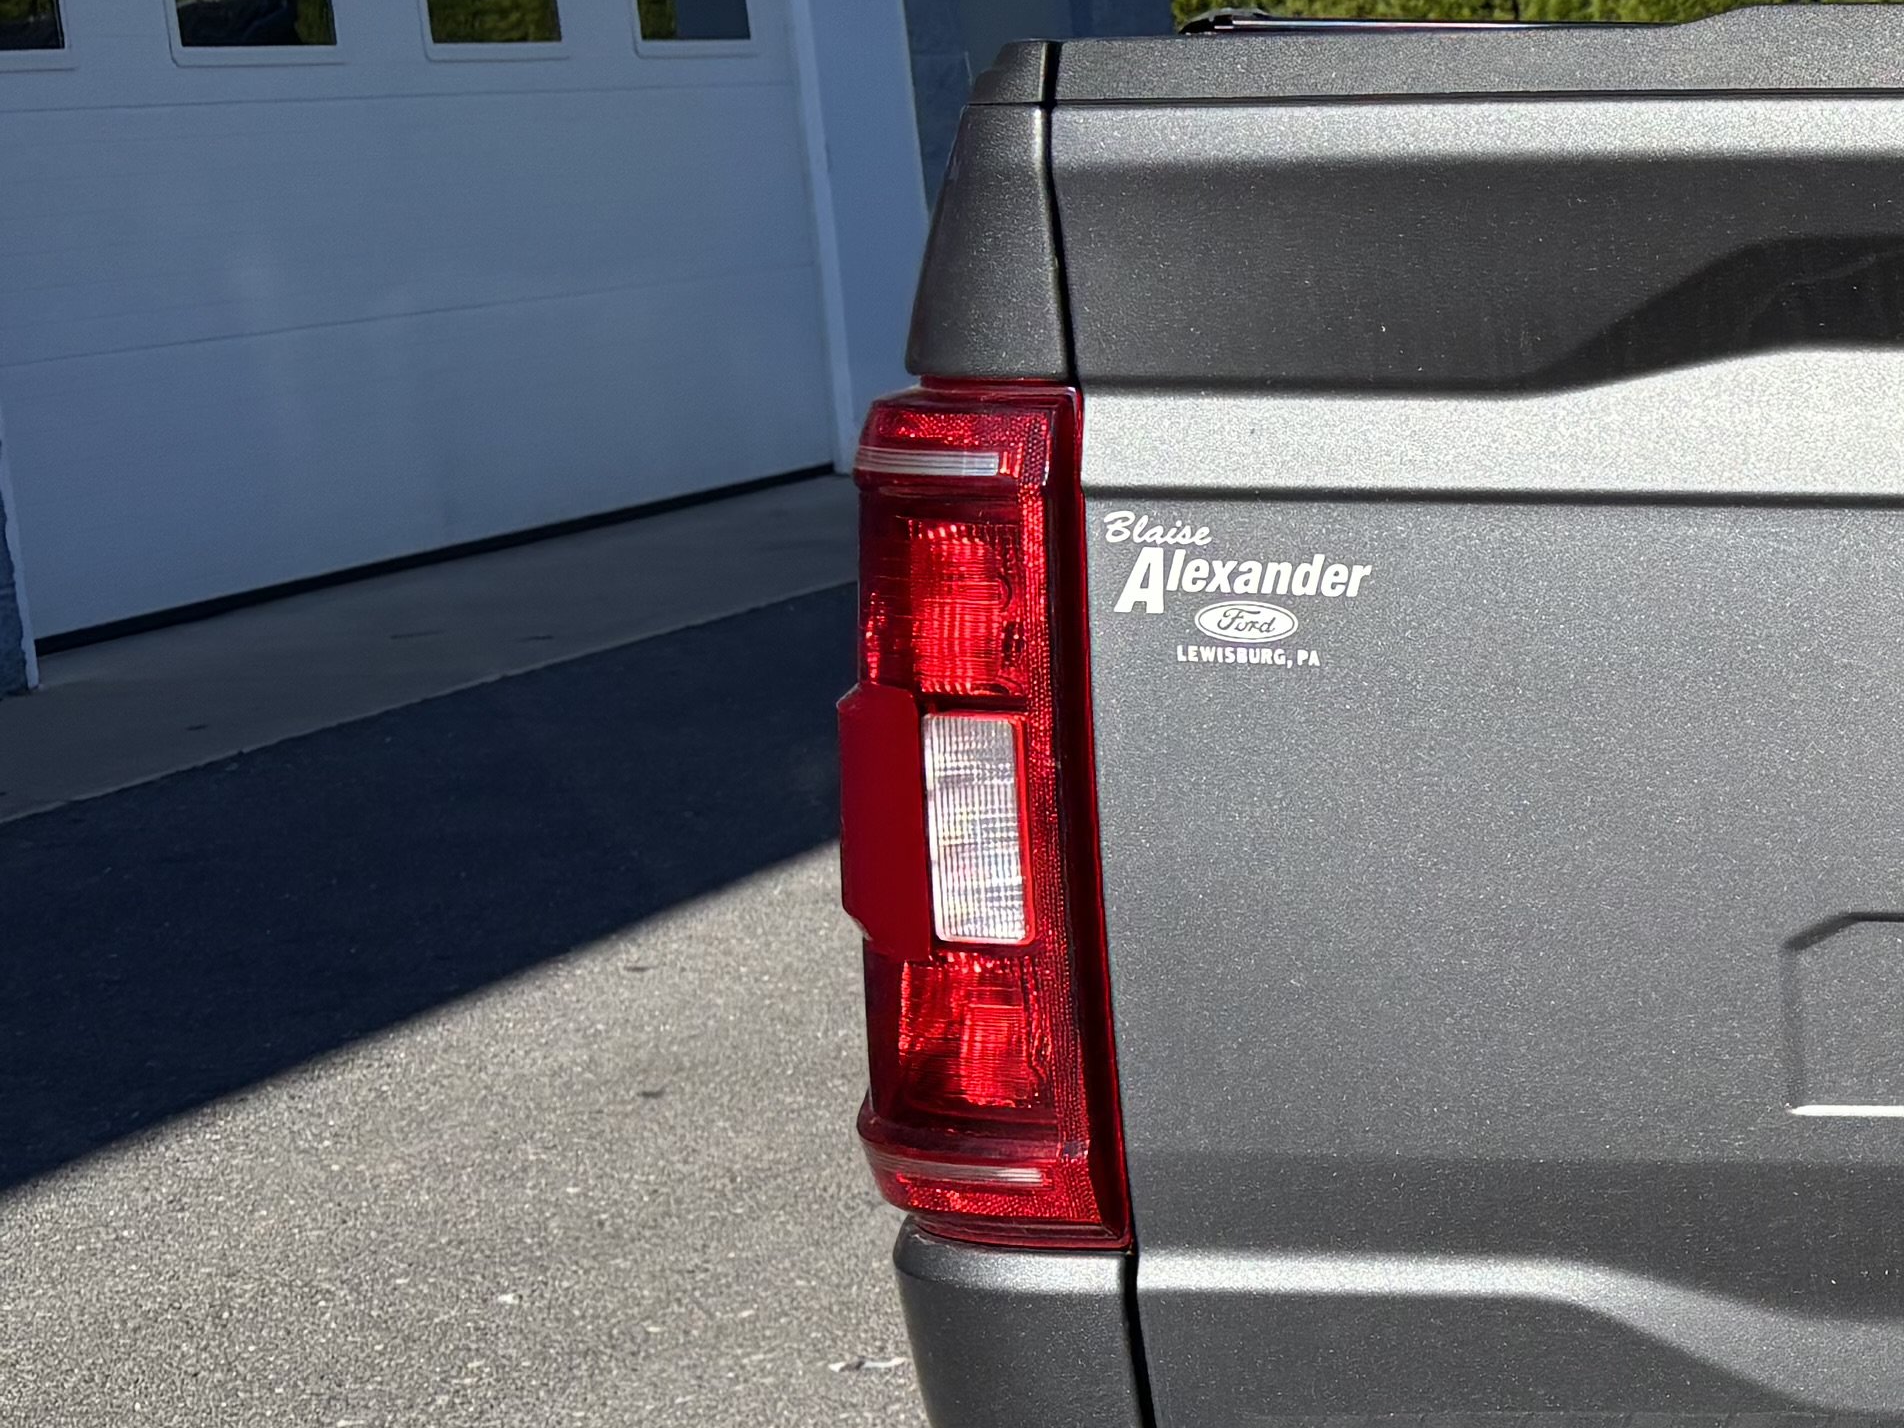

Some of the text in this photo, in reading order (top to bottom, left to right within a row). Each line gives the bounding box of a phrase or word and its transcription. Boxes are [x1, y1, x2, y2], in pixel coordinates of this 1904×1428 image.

[1103, 510, 1213, 546] Blaise
[1113, 546, 1372, 614] Alexander
[1216, 607, 1277, 634] Ford
[1176, 645, 1320, 669] LEWISBURG, PA
